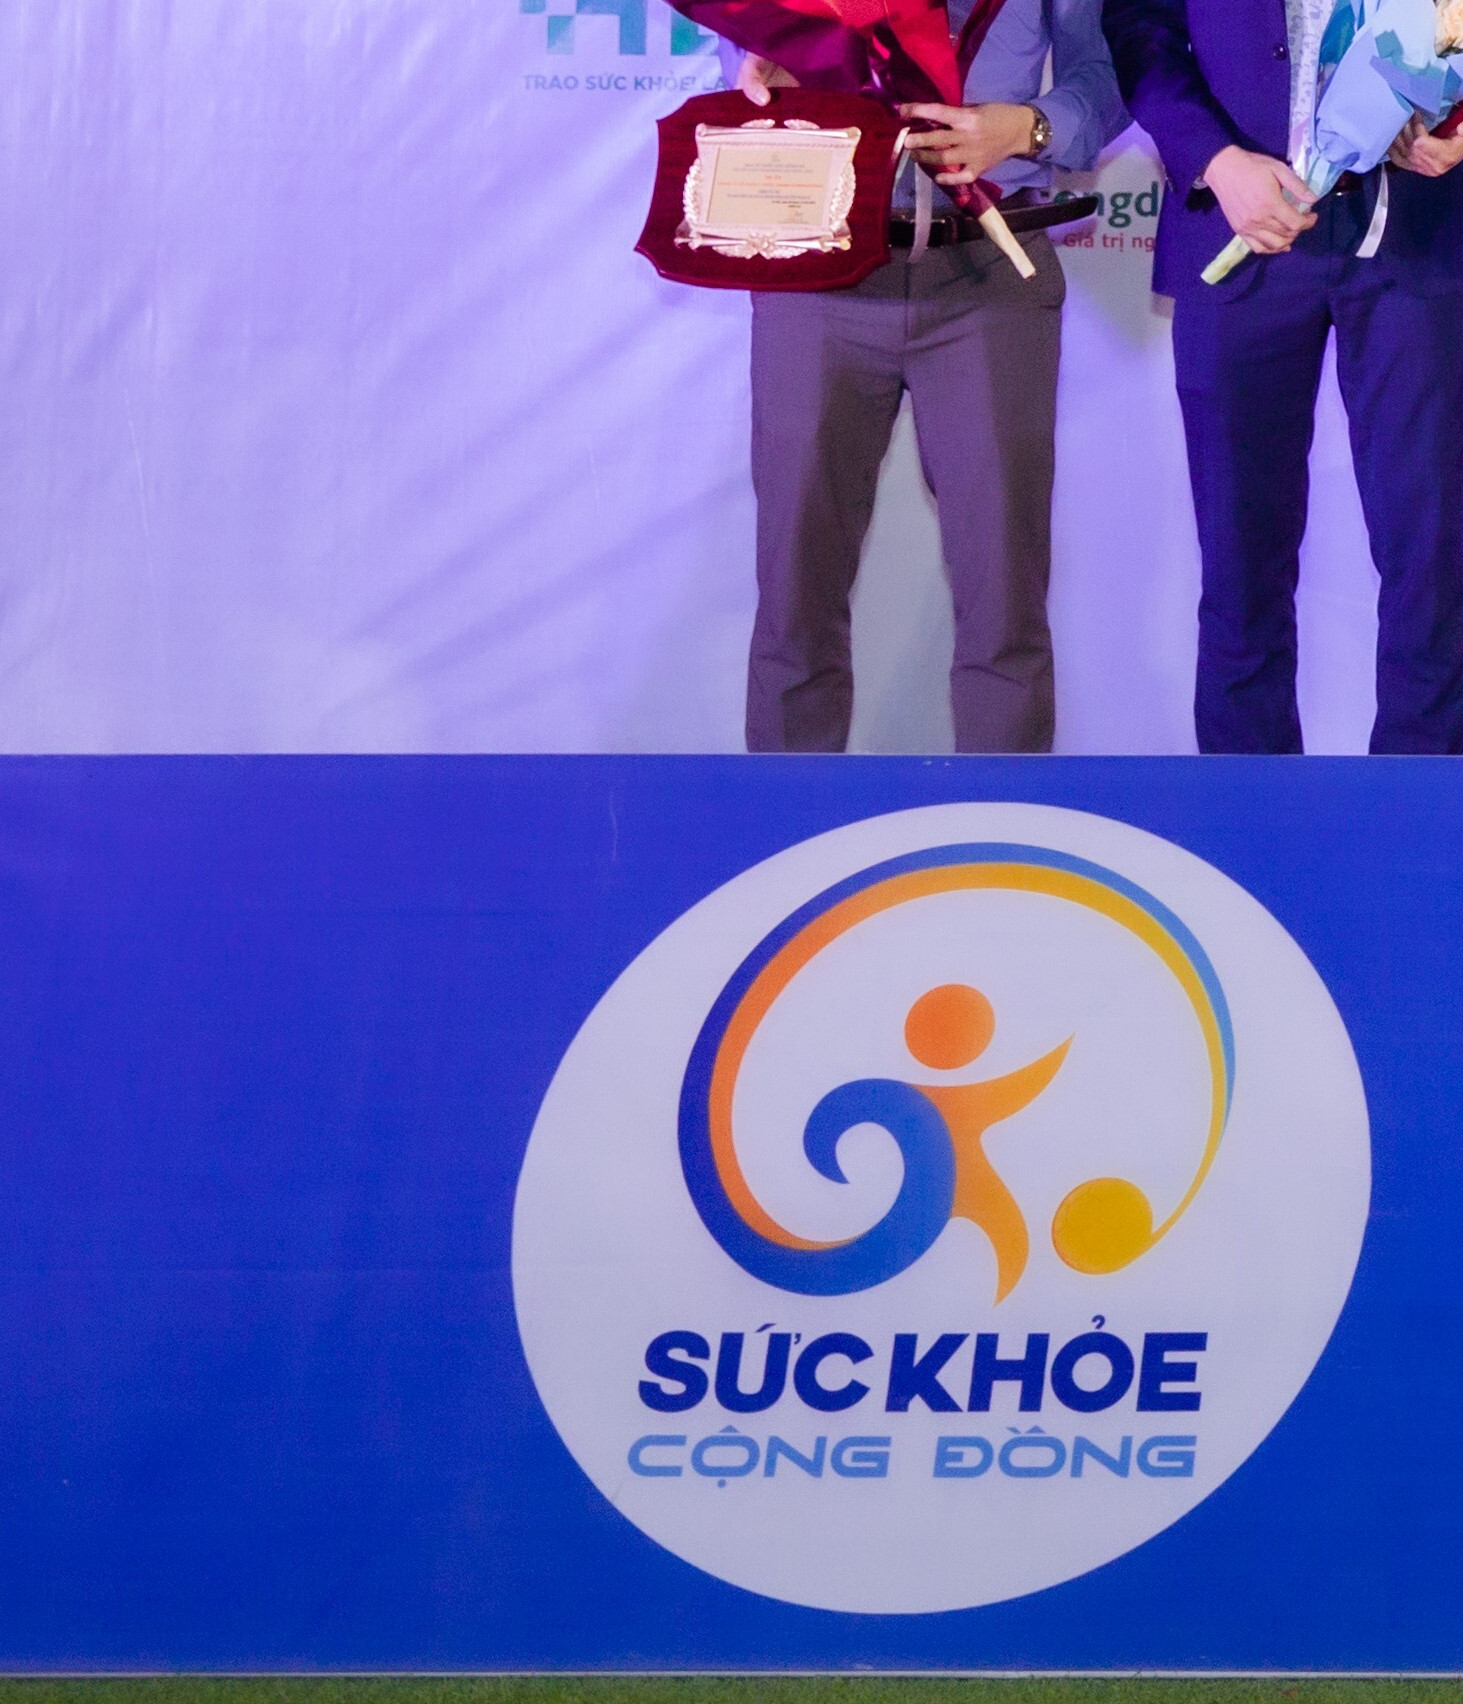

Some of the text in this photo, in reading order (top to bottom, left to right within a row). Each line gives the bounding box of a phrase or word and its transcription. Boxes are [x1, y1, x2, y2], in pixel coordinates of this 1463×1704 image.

[523, 74, 579, 91] TRAO
[638, 1314, 1209, 1415] SỨC KHỎE
[627, 1425, 1198, 1489] CỘNG ĐỒNG
